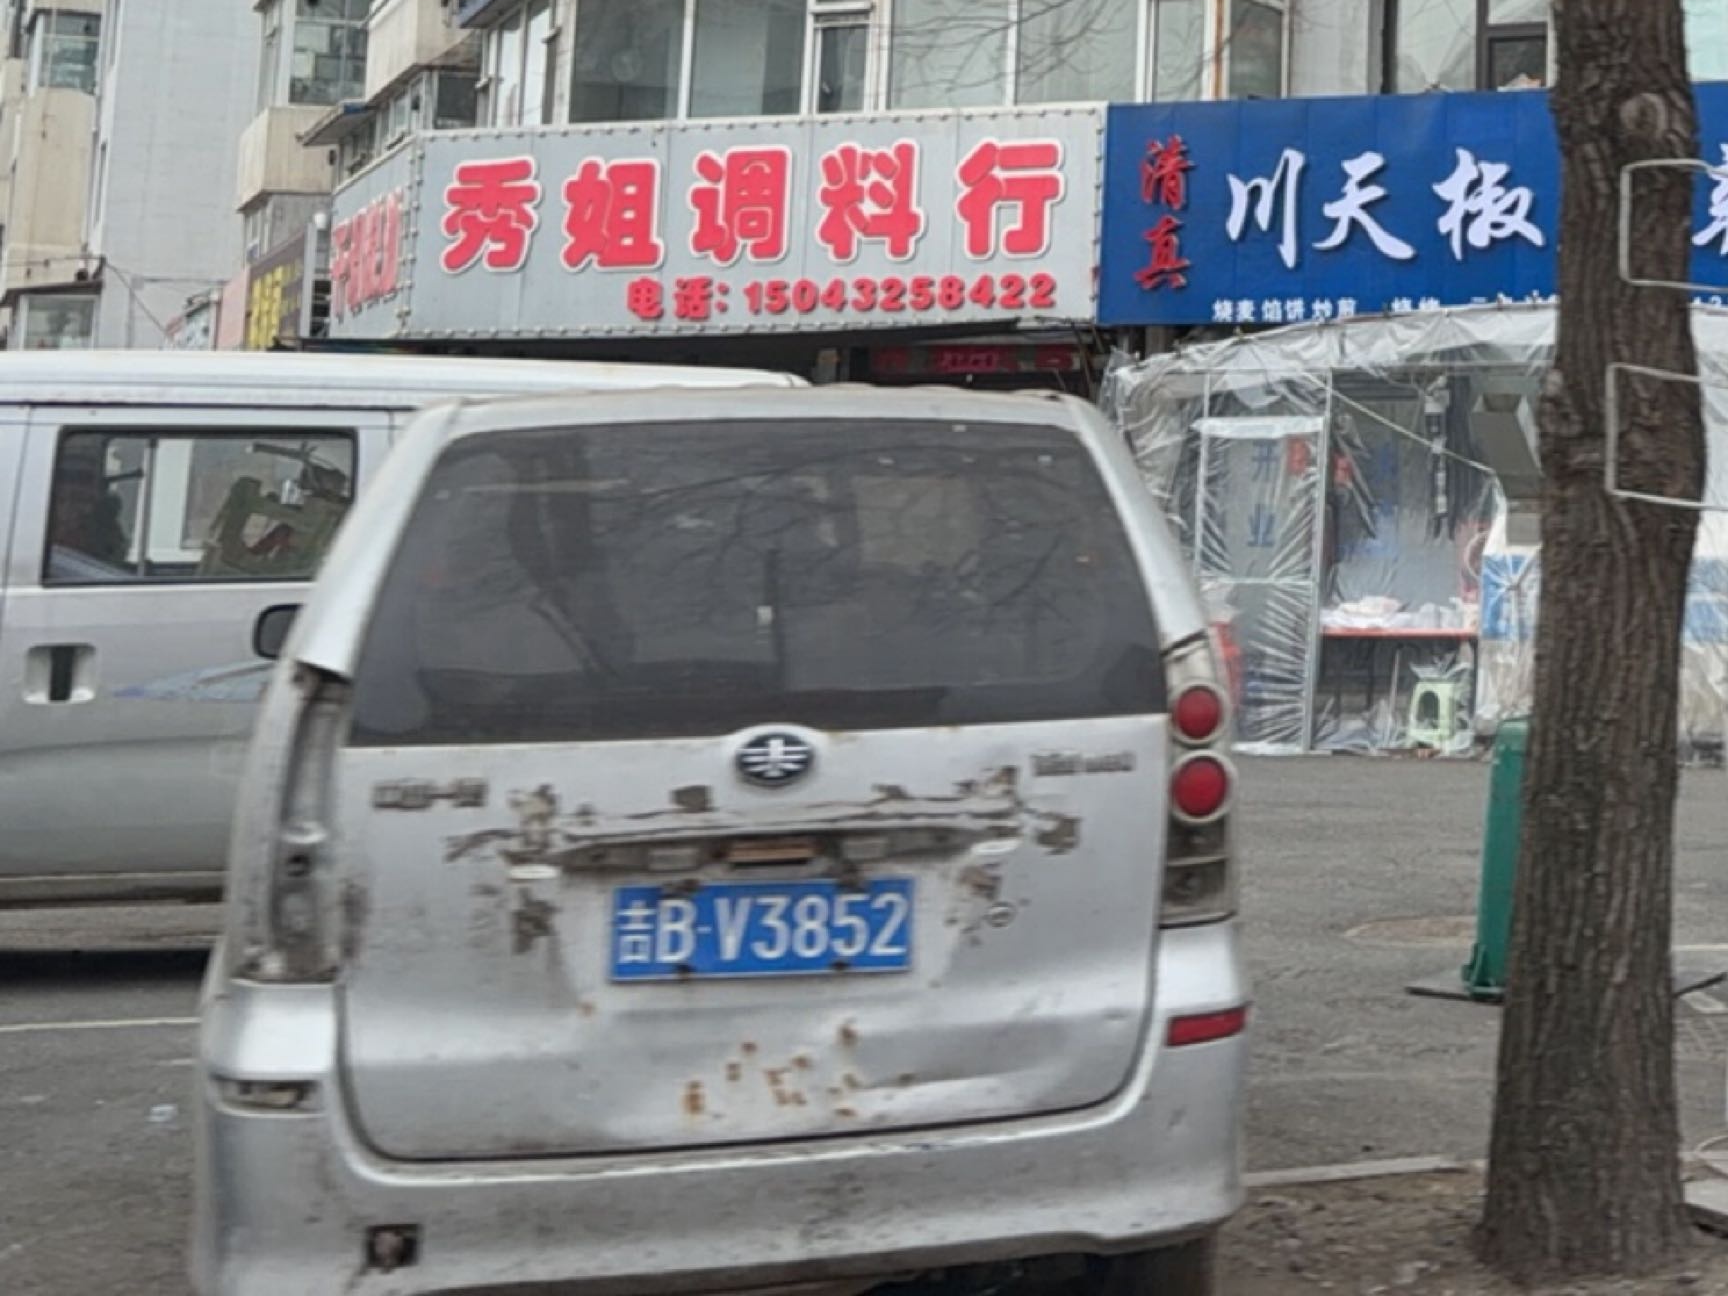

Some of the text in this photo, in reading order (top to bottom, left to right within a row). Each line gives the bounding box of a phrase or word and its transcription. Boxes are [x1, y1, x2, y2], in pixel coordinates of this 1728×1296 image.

[442, 141, 1062, 272] 秀姐调料行
[1136, 136, 1192, 291] 清真
